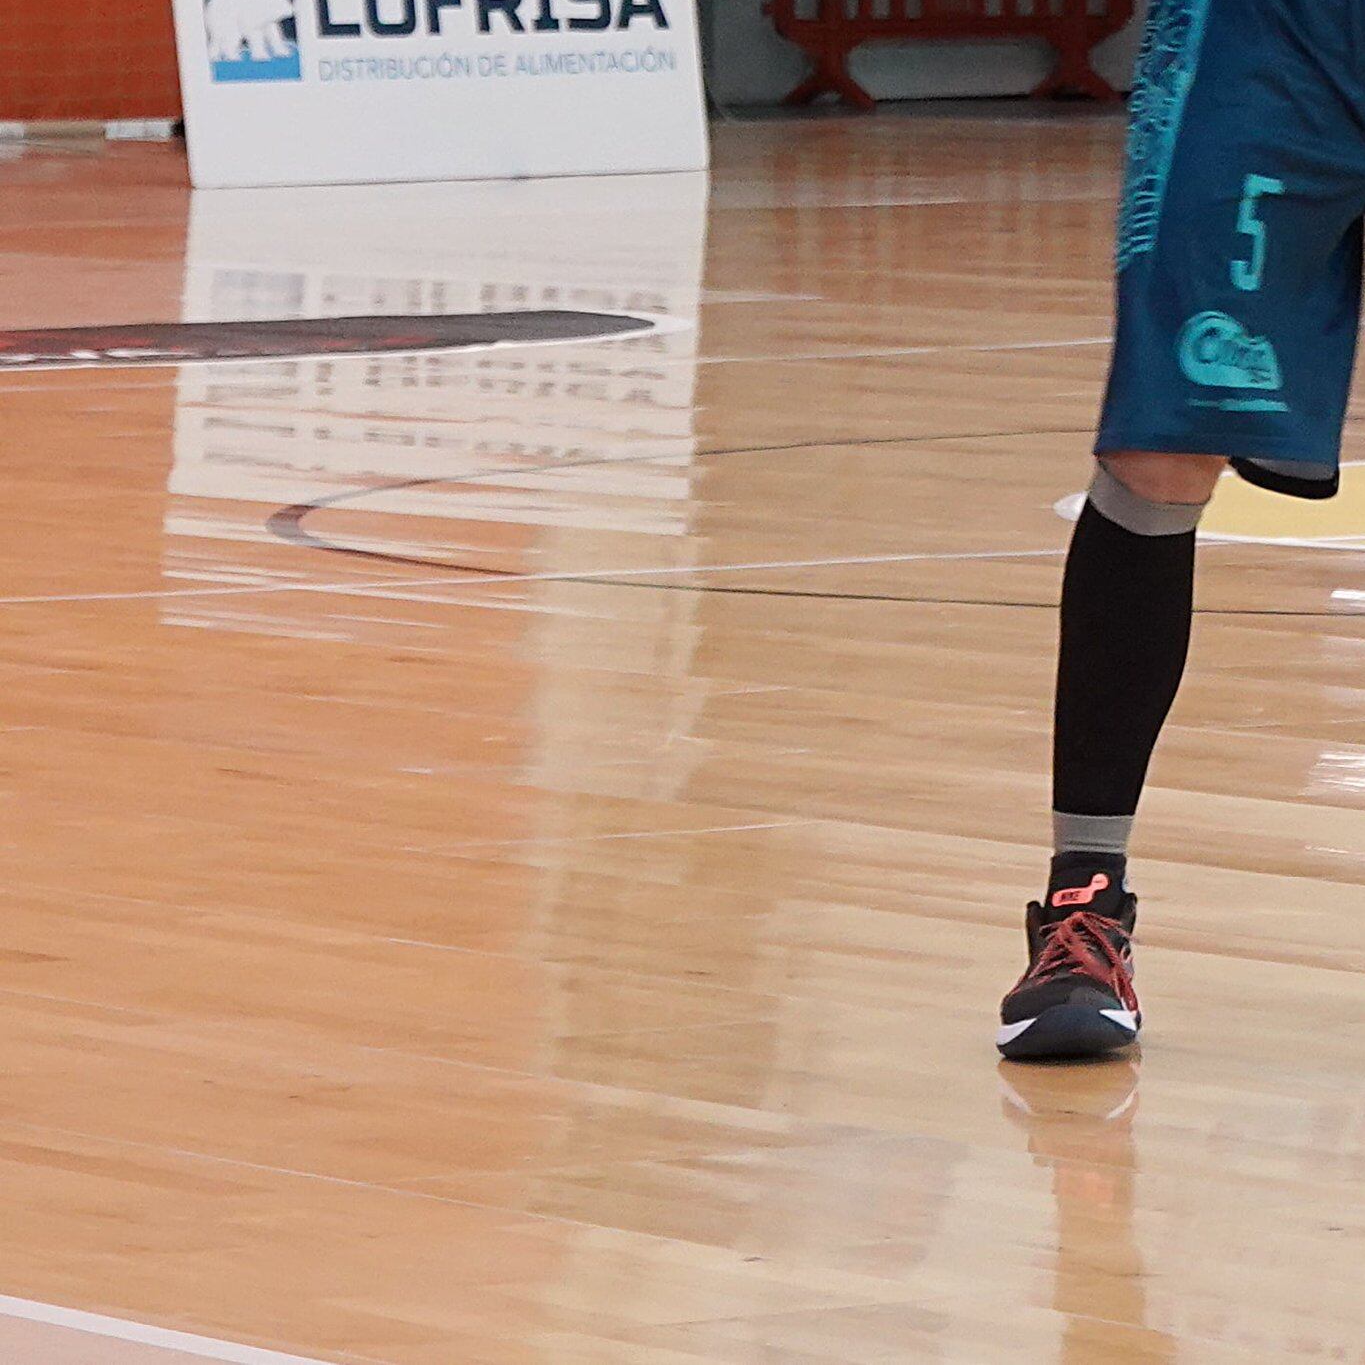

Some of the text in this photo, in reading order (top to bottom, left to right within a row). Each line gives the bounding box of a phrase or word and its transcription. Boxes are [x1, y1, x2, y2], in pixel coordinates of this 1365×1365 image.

[318, 45, 677, 83] DISTRIBUCIÓN DE ALIMENTACIÓN
[1230, 173, 1285, 291] 5
